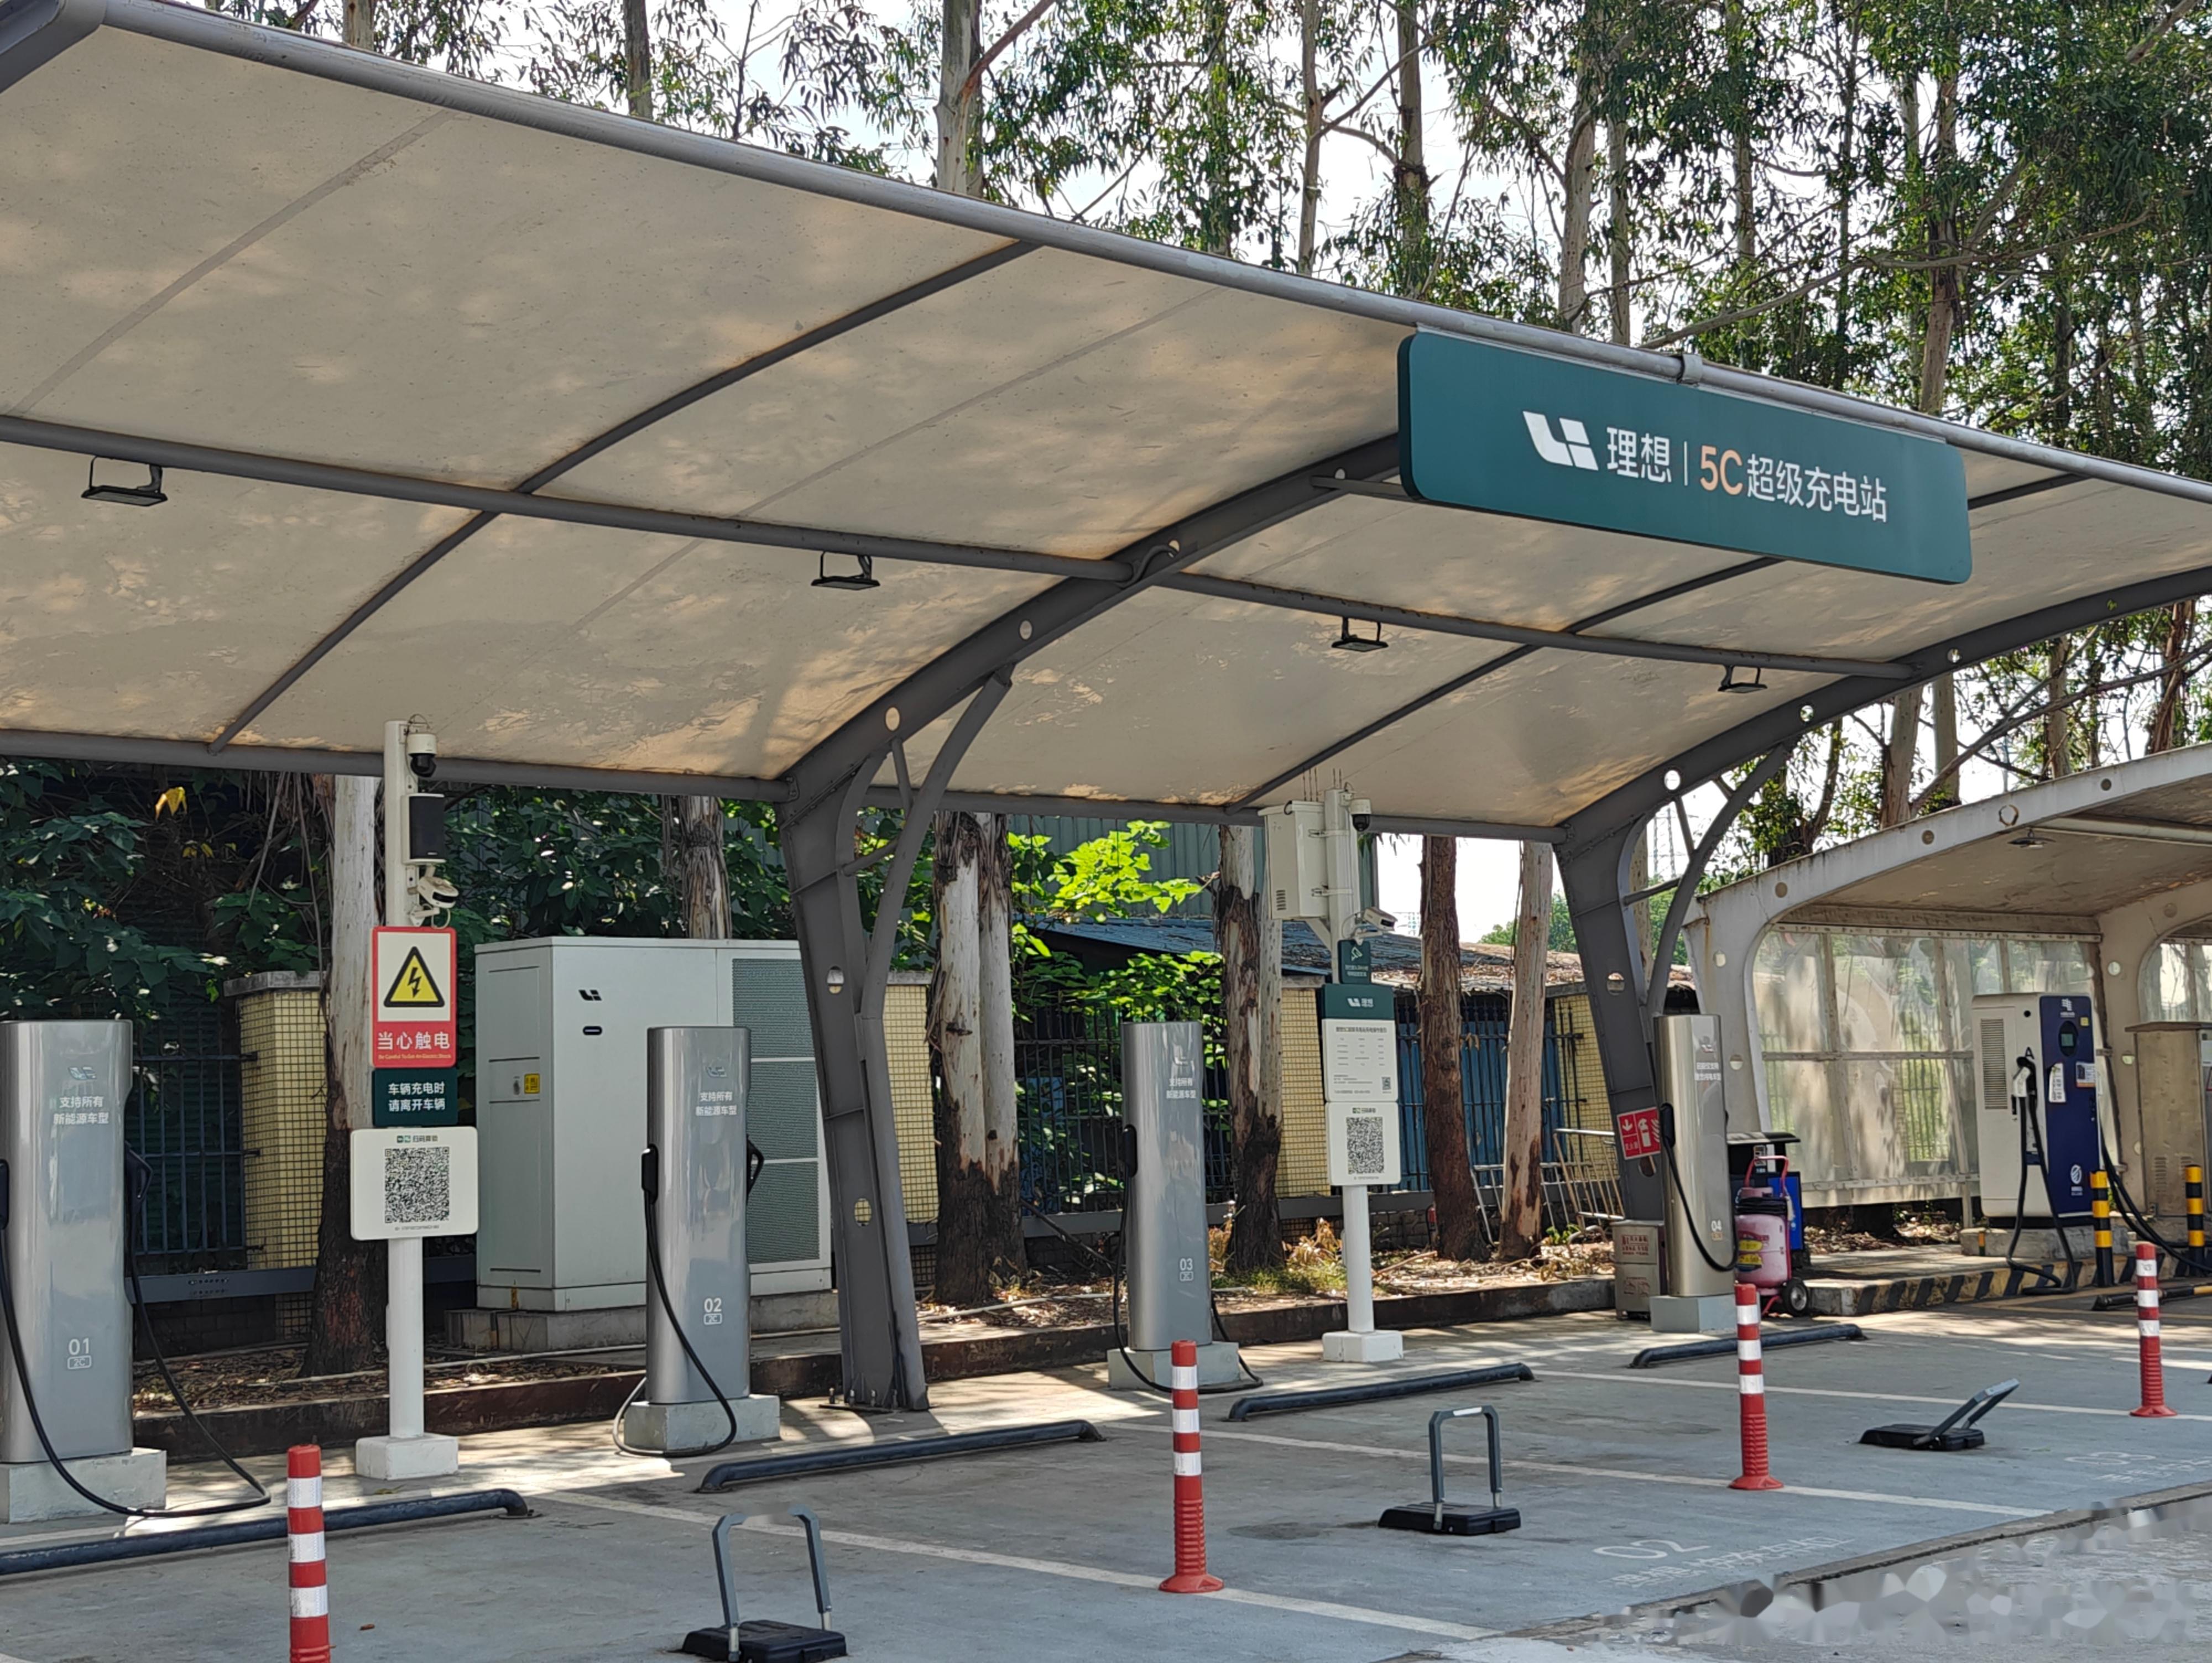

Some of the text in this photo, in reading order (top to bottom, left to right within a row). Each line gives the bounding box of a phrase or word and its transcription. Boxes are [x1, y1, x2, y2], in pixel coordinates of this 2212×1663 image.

[1606, 426, 1672, 483] 理想
[378, 1031, 450, 1050] 当心触电
[2024, 1047, 2034, 1060] A
[388, 1081, 445, 1095] 车辆充电时
[59, 1096, 104, 1108] 支持所有
[700, 1091, 733, 1102] 支持所有
[388, 1098, 446, 1112] 请离开车辆
[696, 1105, 737, 1116] 新能源车型
[53, 1112, 109, 1125] 新能源车型
[1711, 1220, 1722, 1231] 04
[1180, 1258, 1193, 1270] 03
[704, 1298, 722, 1312] 02
[69, 1338, 89, 1356] 01
[2064, 1451, 2156, 1465] 03
[1592, 1539, 1712, 1559] 02
